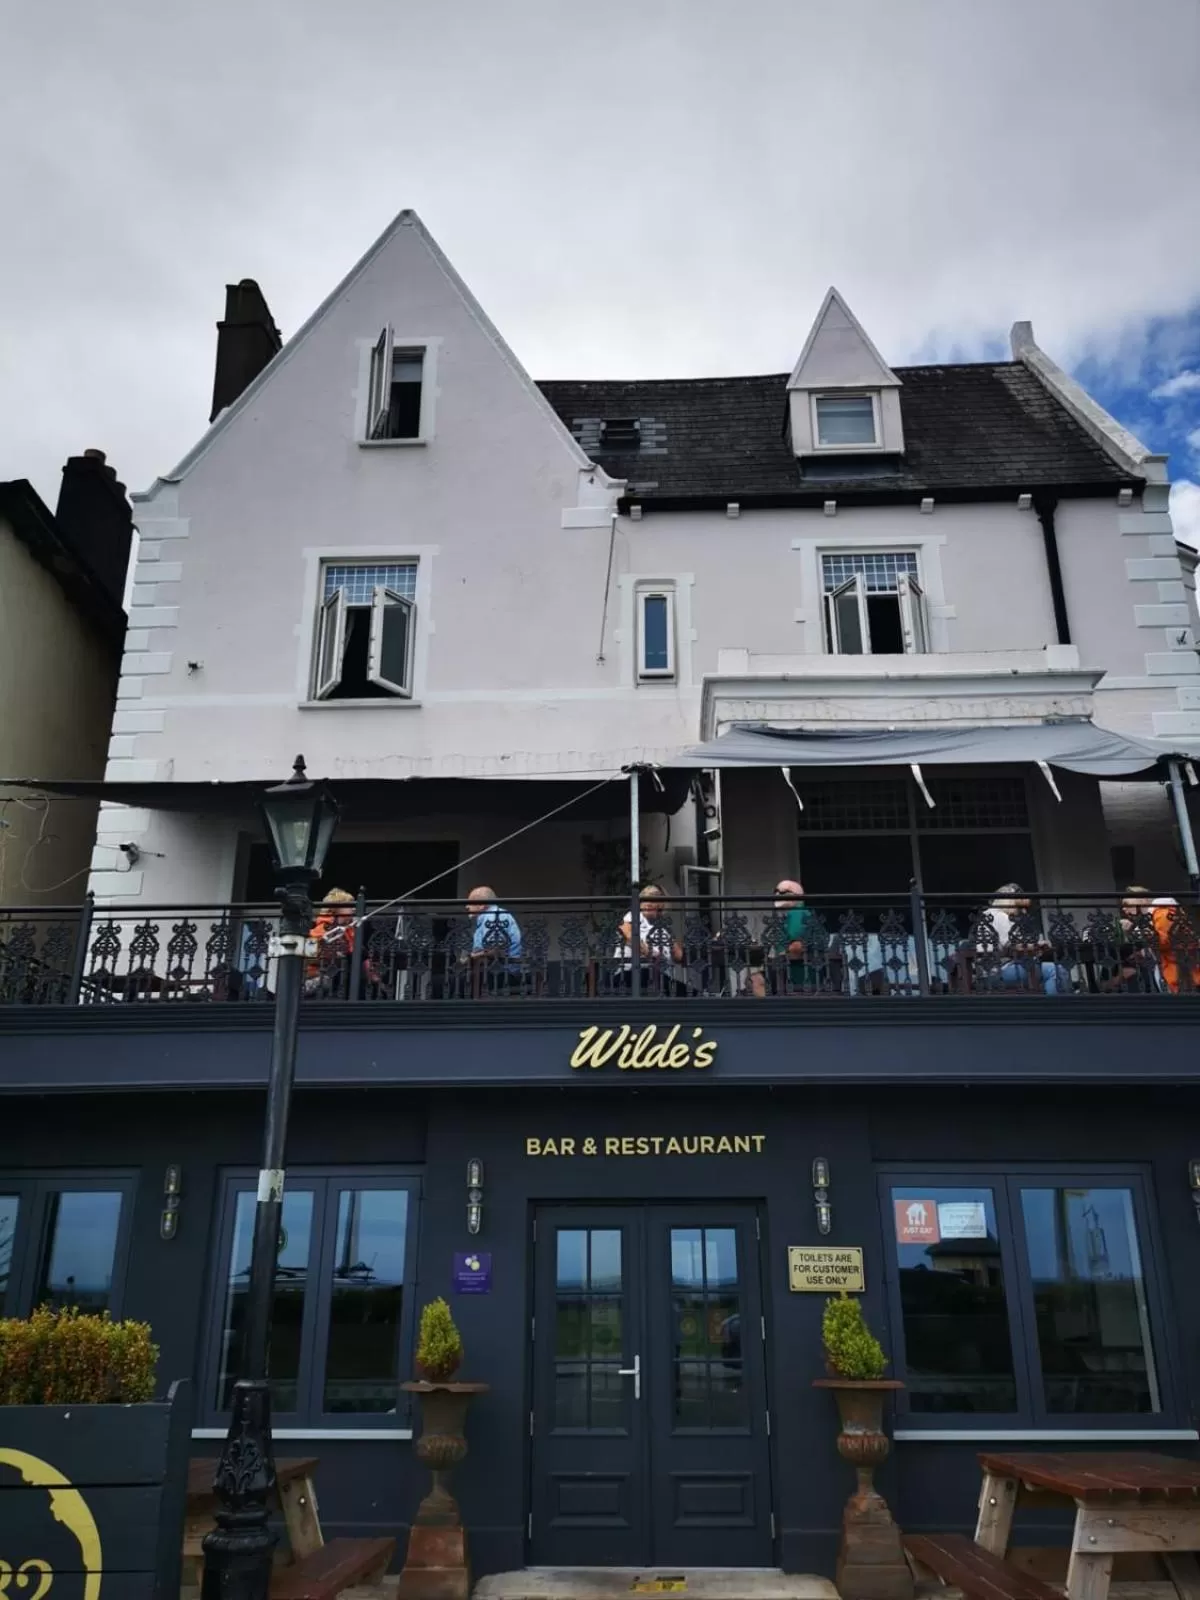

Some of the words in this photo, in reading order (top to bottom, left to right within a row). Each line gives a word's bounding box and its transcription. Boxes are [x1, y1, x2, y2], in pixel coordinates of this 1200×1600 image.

[570, 1024, 718, 1069] Wilde's
[526, 1137, 575, 1155] BAR
[582, 1137, 597, 1155] &
[605, 1135, 766, 1155] RESTAURANT
[799, 1253, 833, 1263] TOILETS
[835, 1254, 853, 1263] ARE
[793, 1264, 812, 1273] FOR
[812, 1265, 860, 1274] CUSTOMER
[806, 1276, 824, 1284] USE
[825, 1275, 848, 1285] ONLY
